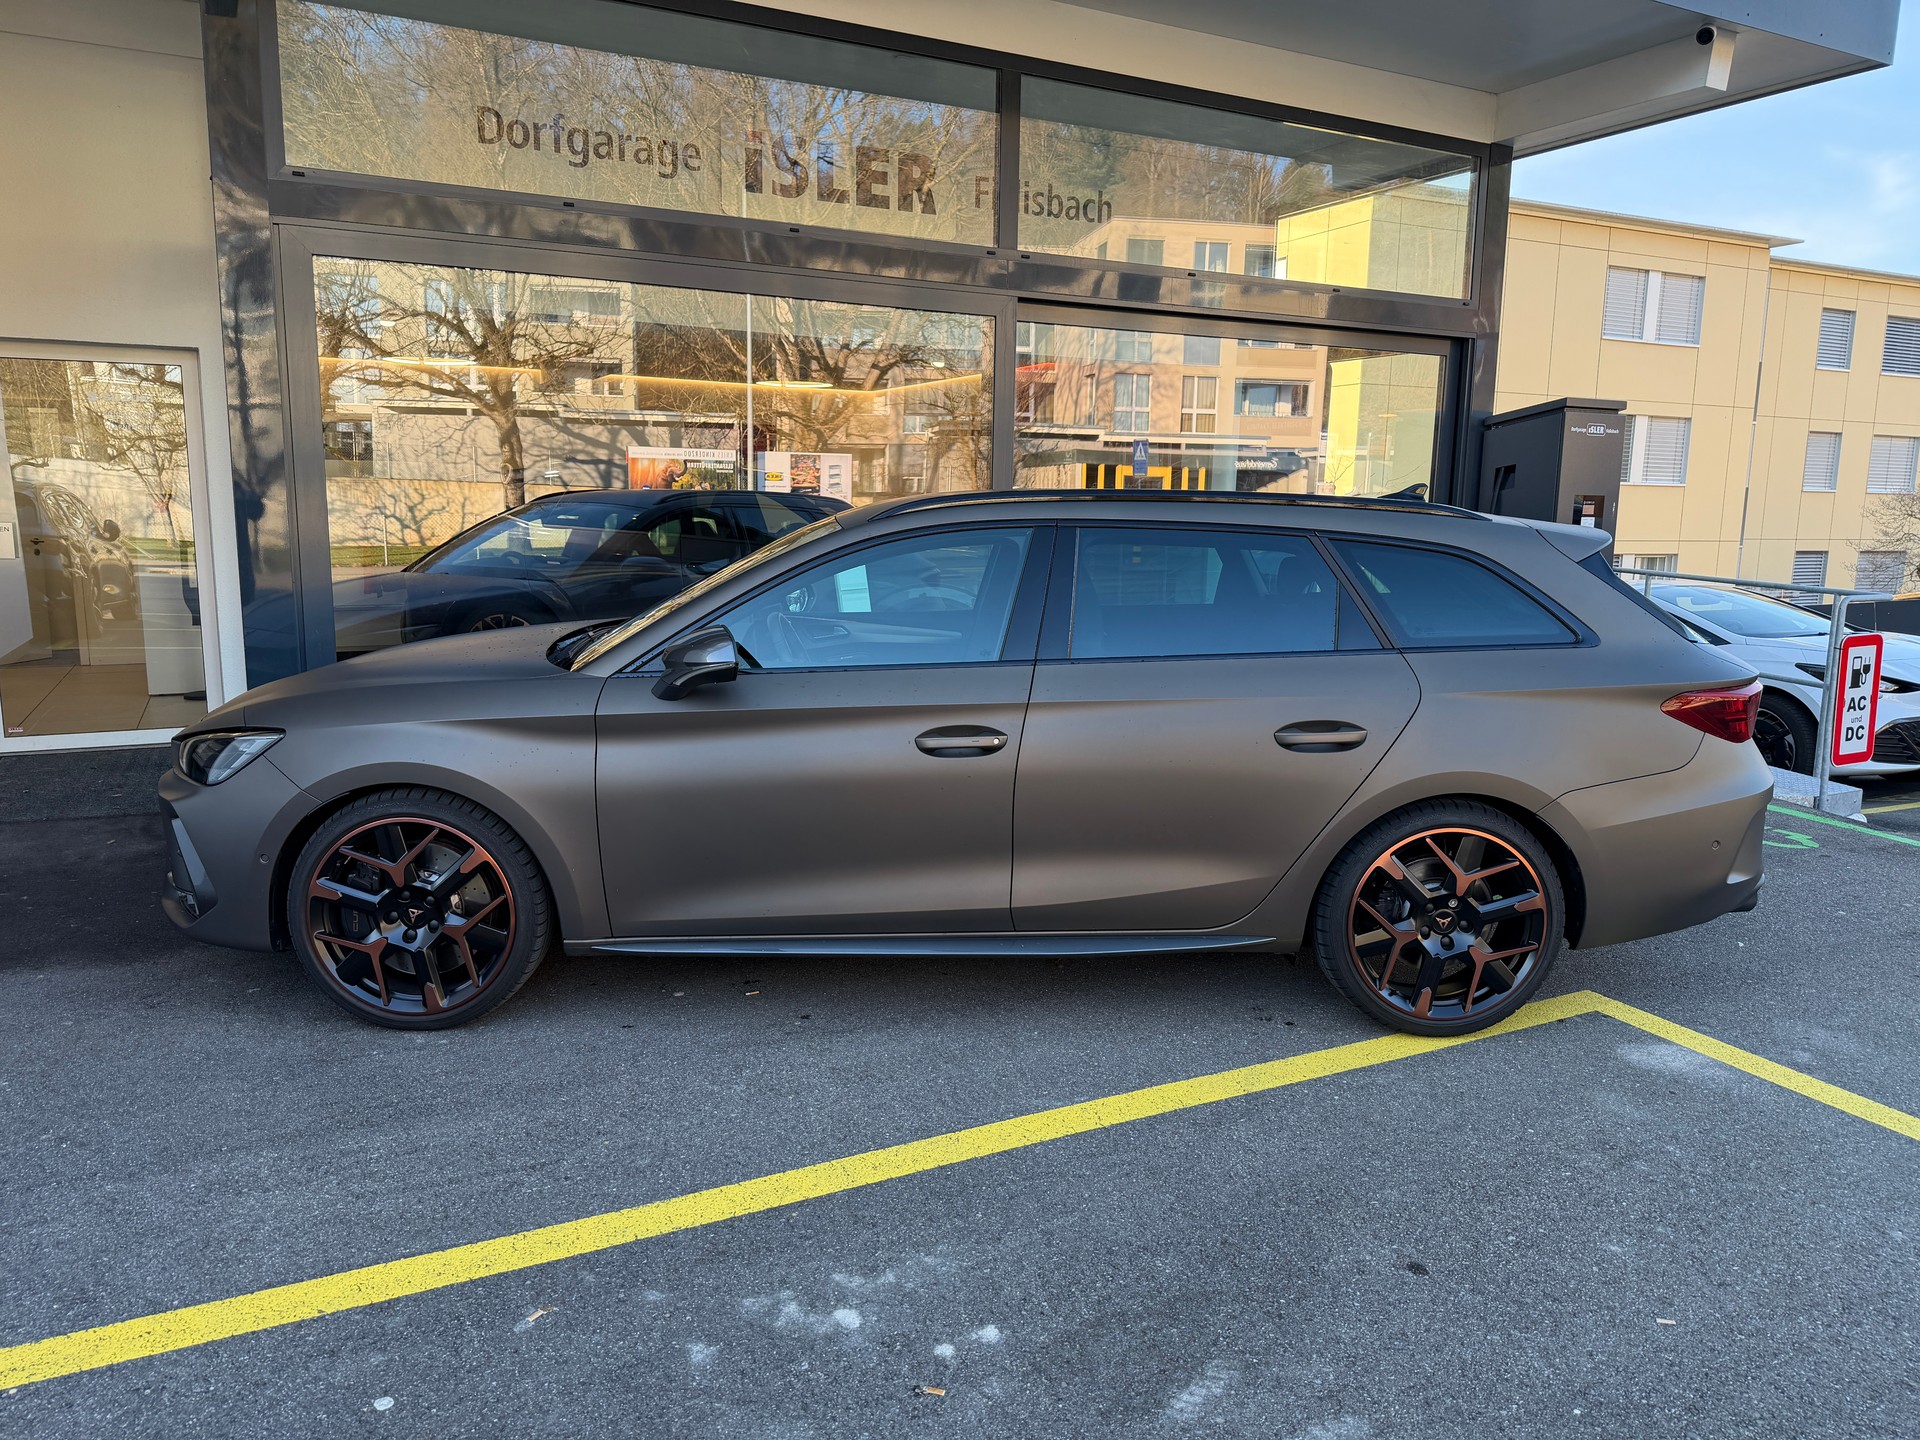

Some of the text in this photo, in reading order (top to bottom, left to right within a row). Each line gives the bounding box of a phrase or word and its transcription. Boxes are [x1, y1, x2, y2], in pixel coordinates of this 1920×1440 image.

[476, 105, 701, 179] Dorfgarage
[1847, 695, 1867, 712] AC
[1850, 715, 1863, 723] und
[1845, 725, 1865, 742] DC
